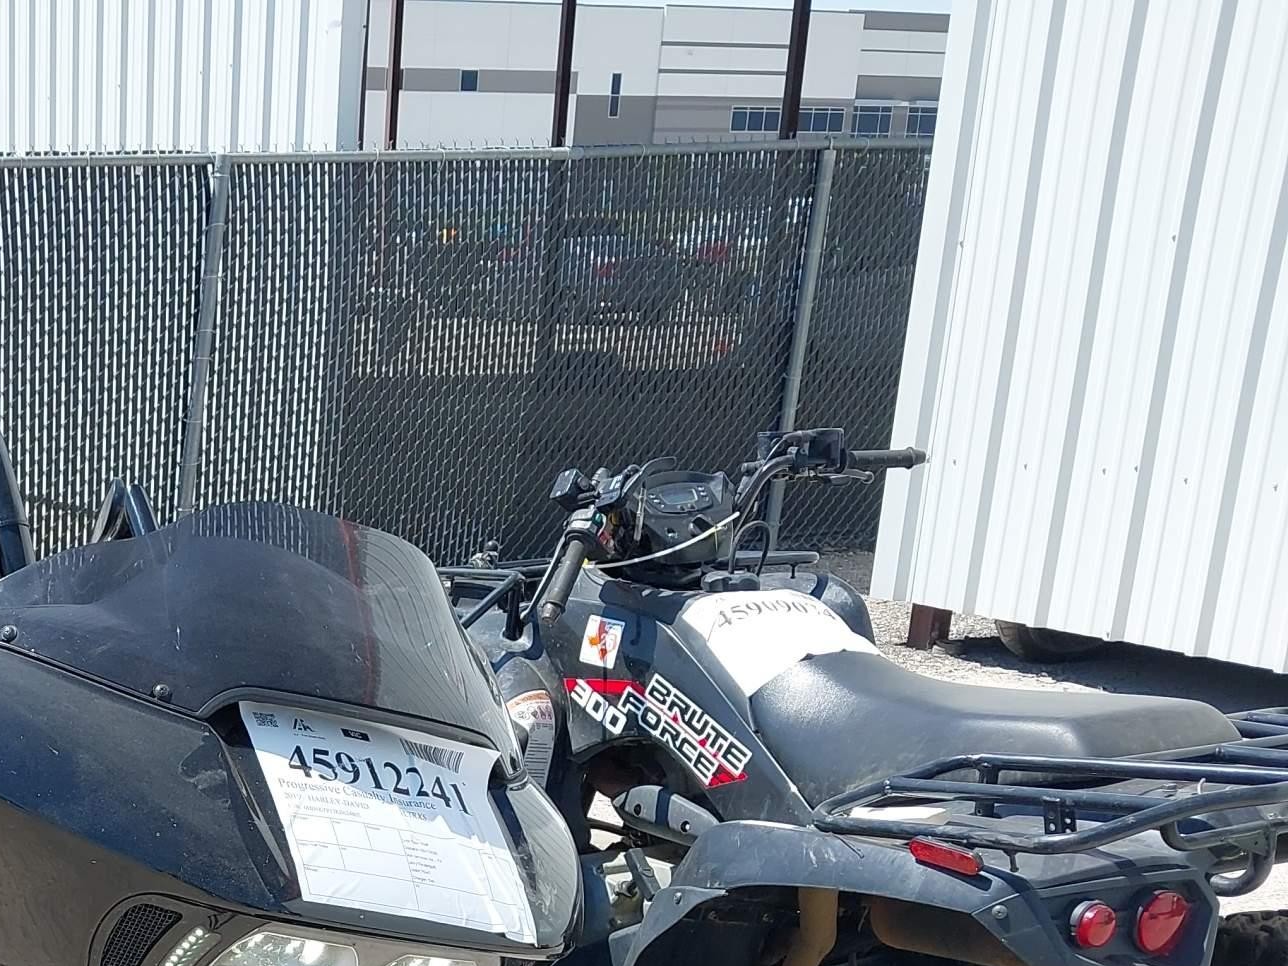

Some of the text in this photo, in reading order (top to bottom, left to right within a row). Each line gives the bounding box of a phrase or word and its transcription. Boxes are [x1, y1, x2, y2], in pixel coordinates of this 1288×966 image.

[571, 679, 627, 734] 300
[618, 686, 719, 784] FORCE
[646, 674, 751, 776] BRUTE
[278, 778, 437, 810] Progressive Casualty Insurance
[288, 745, 473, 816] 45912241
